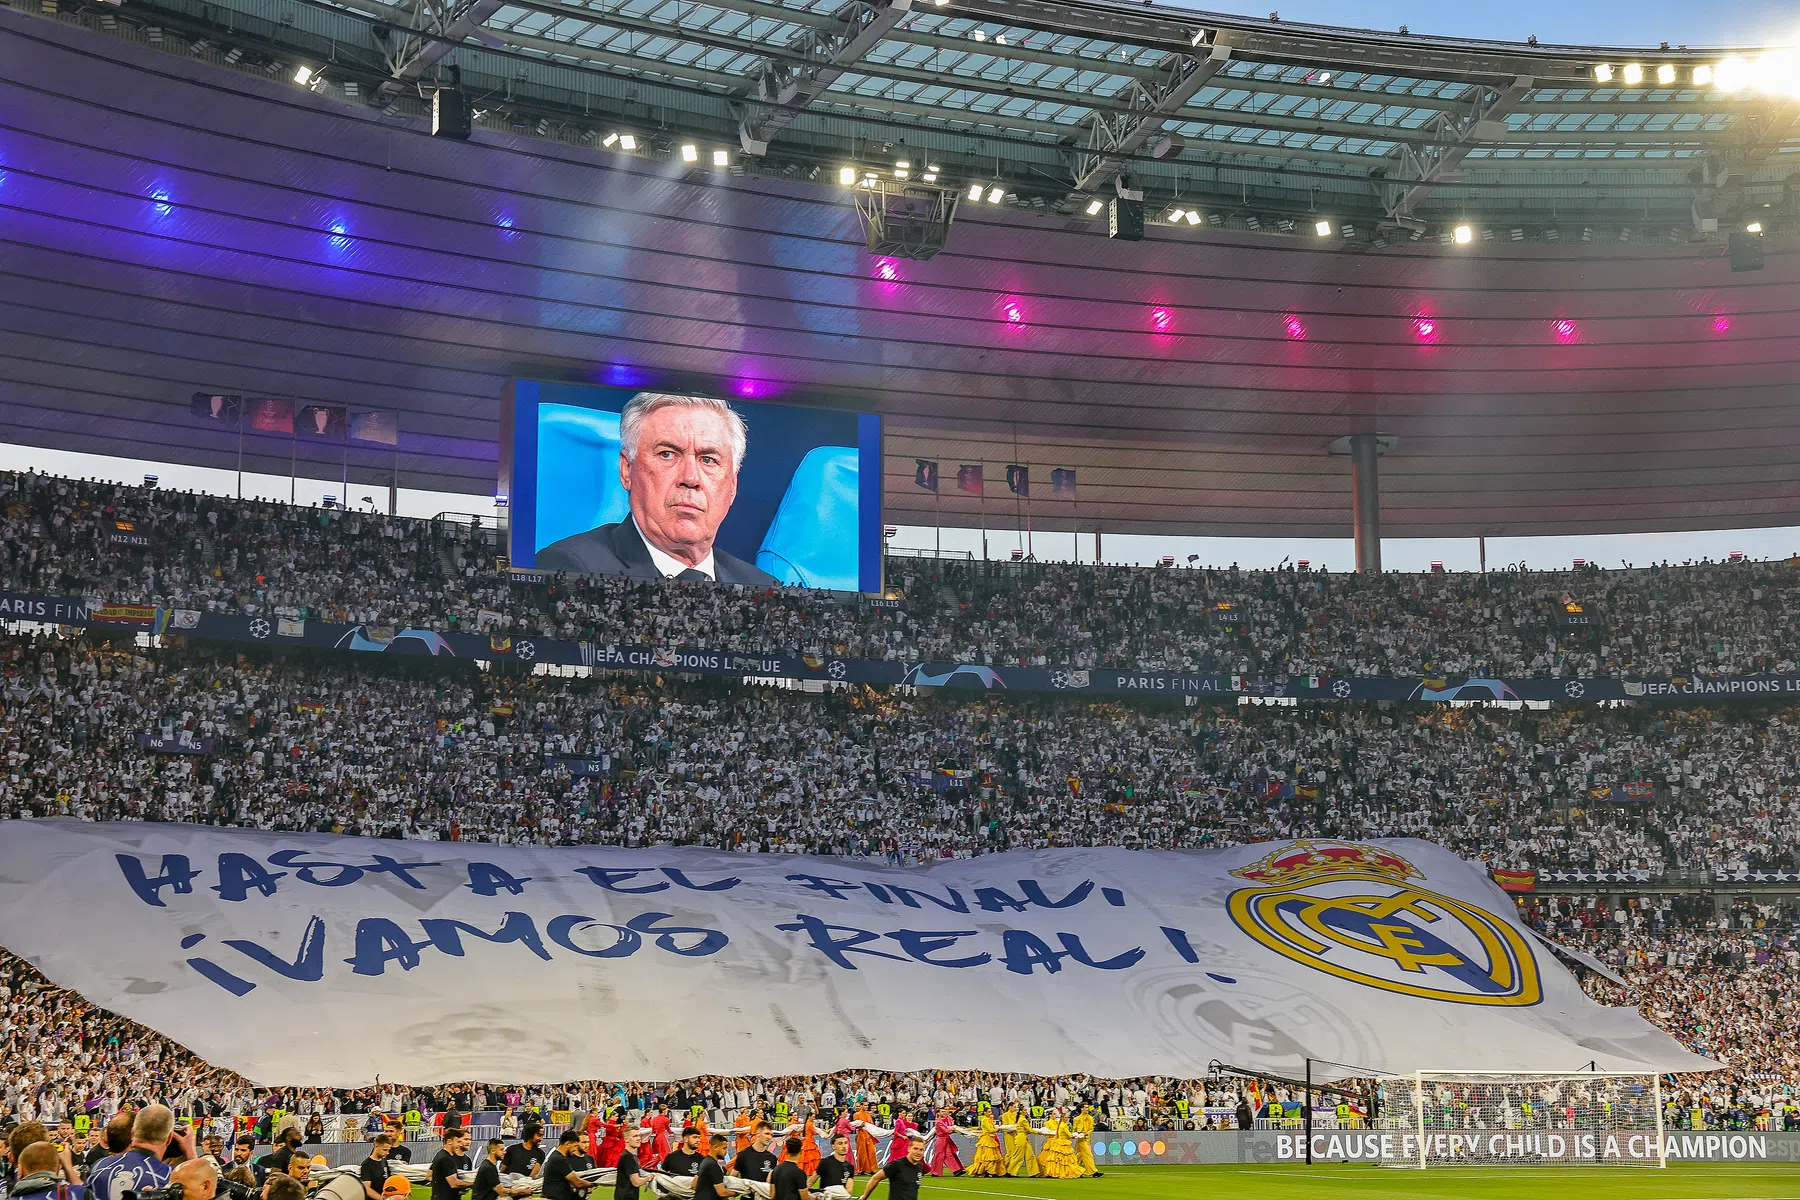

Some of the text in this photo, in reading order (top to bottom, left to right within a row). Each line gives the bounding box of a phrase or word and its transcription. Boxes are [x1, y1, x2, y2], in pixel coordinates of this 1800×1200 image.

[110, 534, 148, 545] N12 N11
[511, 574, 542, 583] L18 L17
[0, 598, 88, 620] ARIS FIN
[871, 599, 899, 608] L16 L15
[597, 649, 625, 664] EFA
[629, 651, 719, 669] CHAPIONS
[1117, 676, 1165, 690] PARIS
[1172, 678, 1221, 692] FINAL
[1682, 679, 1780, 694] CHAMPIONS
[150, 739, 202, 750] N6 N5
[588, 764, 600, 772] N3
[117, 849, 530, 907] HASTA
[574, 866, 742, 895] EL
[1539, 869, 1552, 882] 5
[1716, 869, 1729, 882] 5
[1277, 1134, 1393, 1158] BECAUSE
[1402, 1134, 1480, 1158] EVERY
[1488, 1134, 1566, 1158] CHILD
[1574, 1134, 1596, 1158] IS
[1603, 1134, 1622, 1159] A
[1628, 1134, 1767, 1159] CHAMPION
